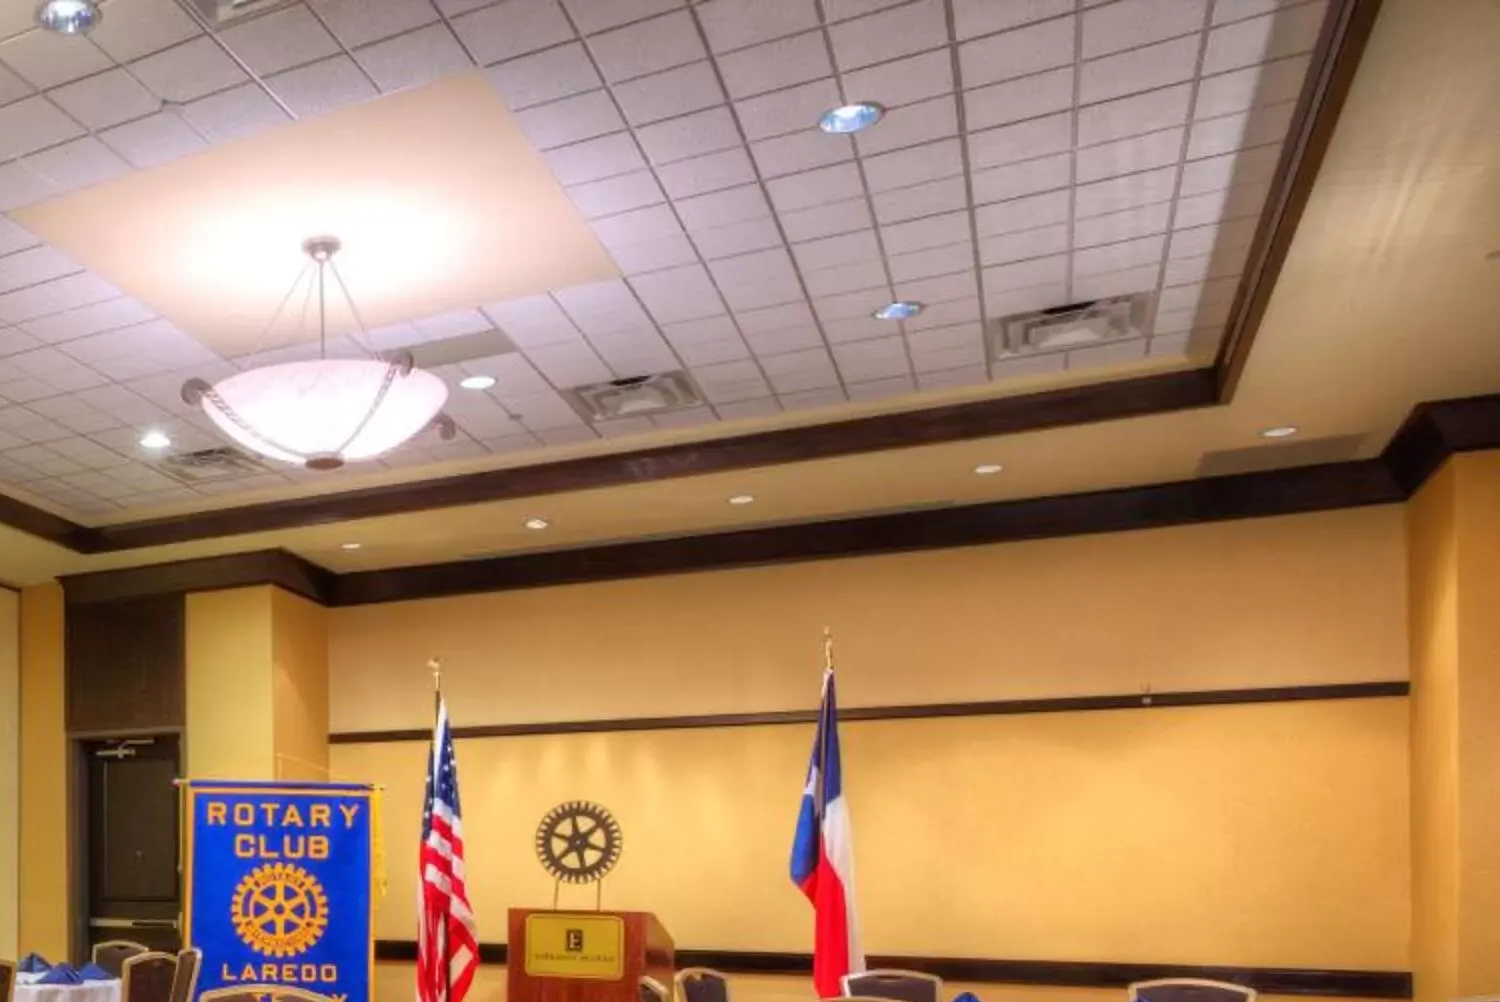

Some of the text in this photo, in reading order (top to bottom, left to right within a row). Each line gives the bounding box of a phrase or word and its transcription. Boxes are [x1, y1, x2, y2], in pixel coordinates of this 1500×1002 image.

[207, 801, 360, 828] ROTARY
[235, 833, 329, 860] CLUB
[222, 962, 337, 983] LAREDO
